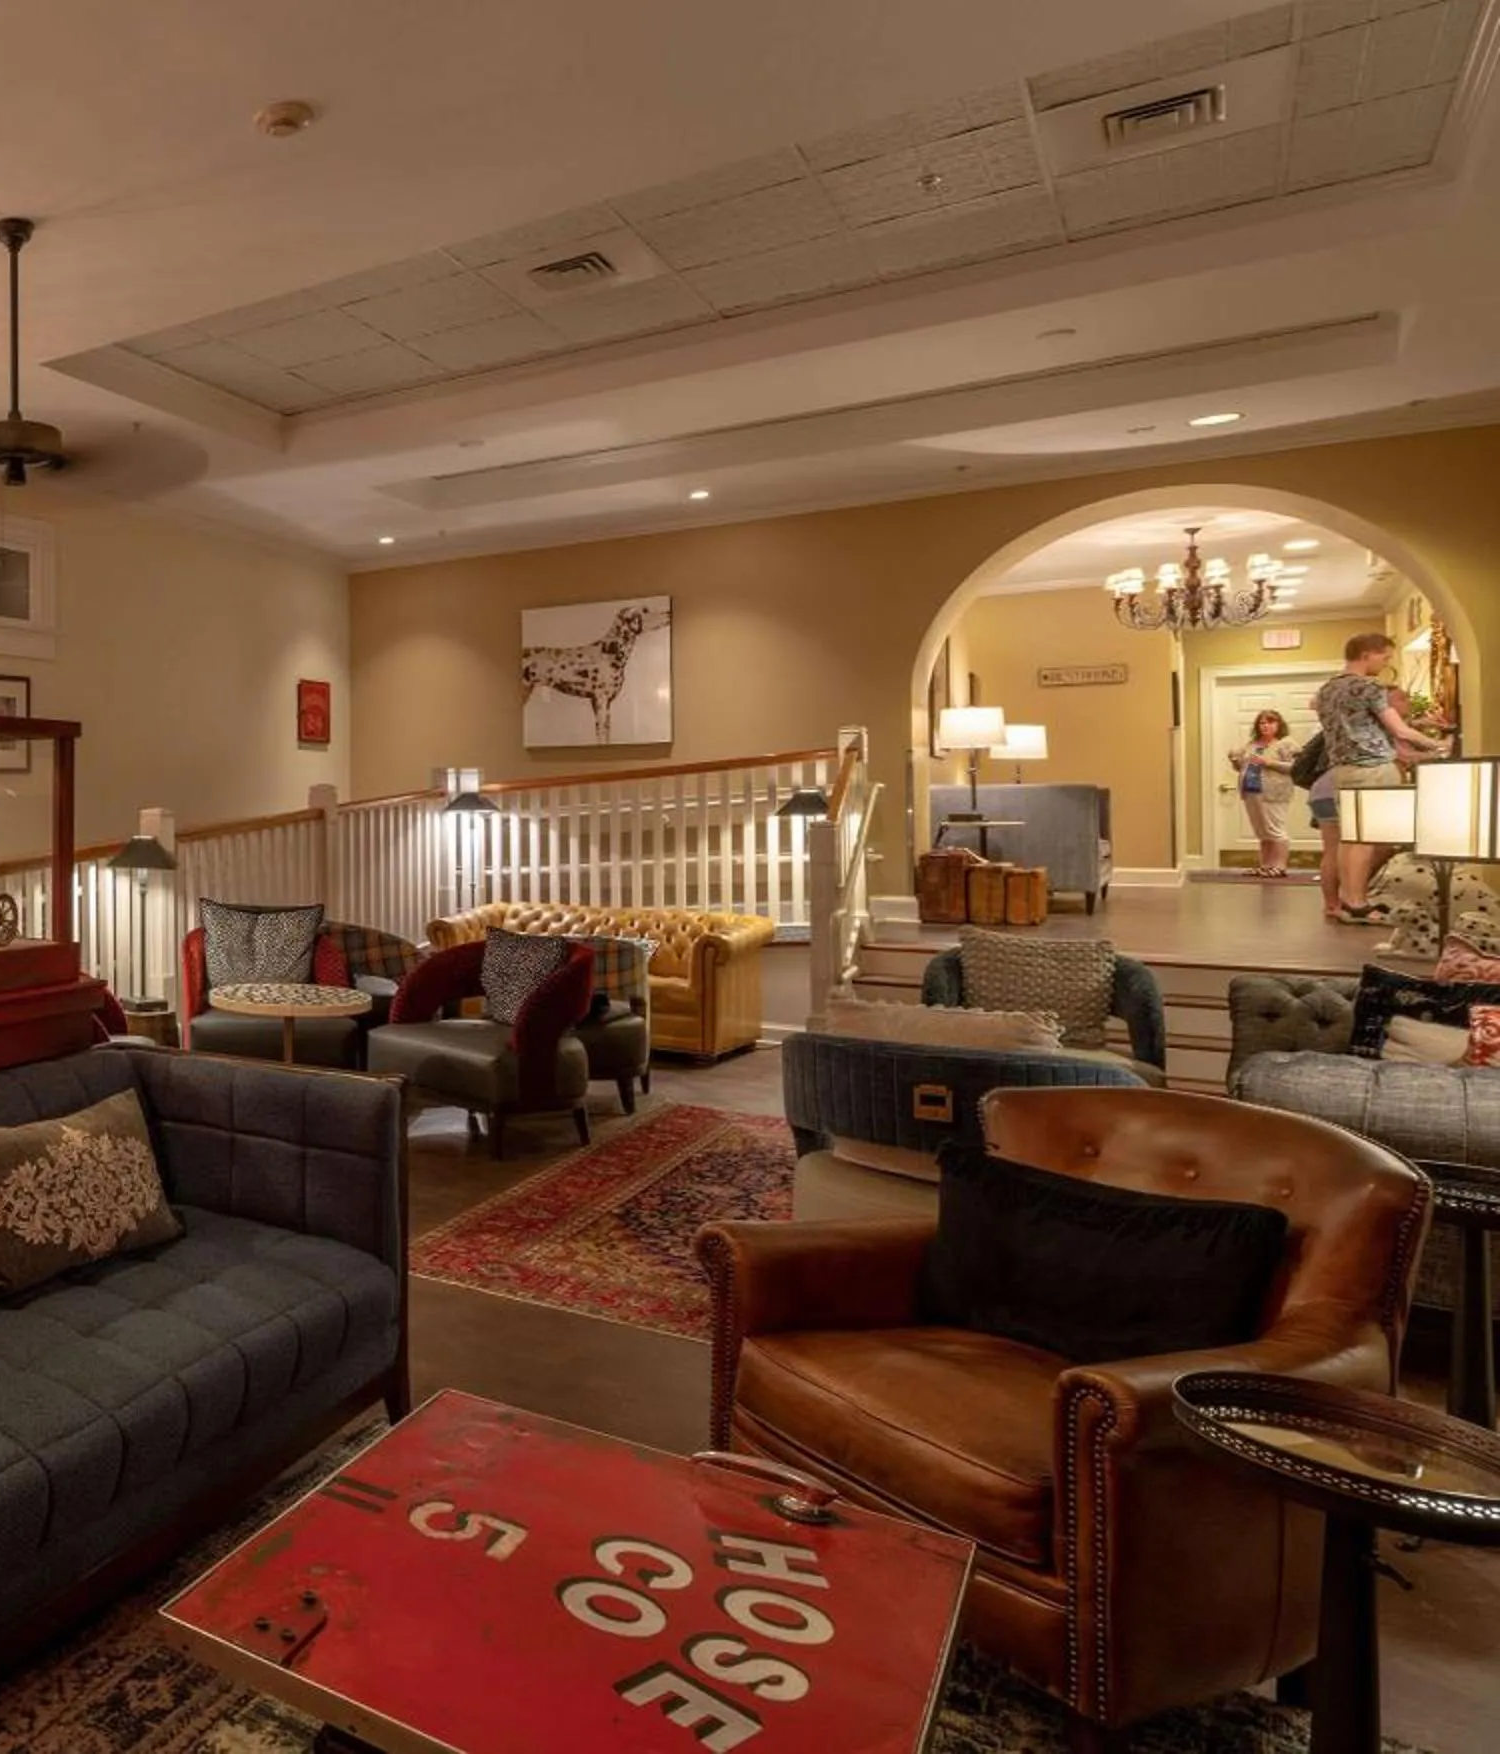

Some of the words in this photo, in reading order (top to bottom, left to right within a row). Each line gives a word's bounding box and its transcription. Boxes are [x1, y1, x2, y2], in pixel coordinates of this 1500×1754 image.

[408, 1500, 529, 1562] 5
[558, 1537, 694, 1638] CO
[620, 1534, 836, 1753] HOSE
